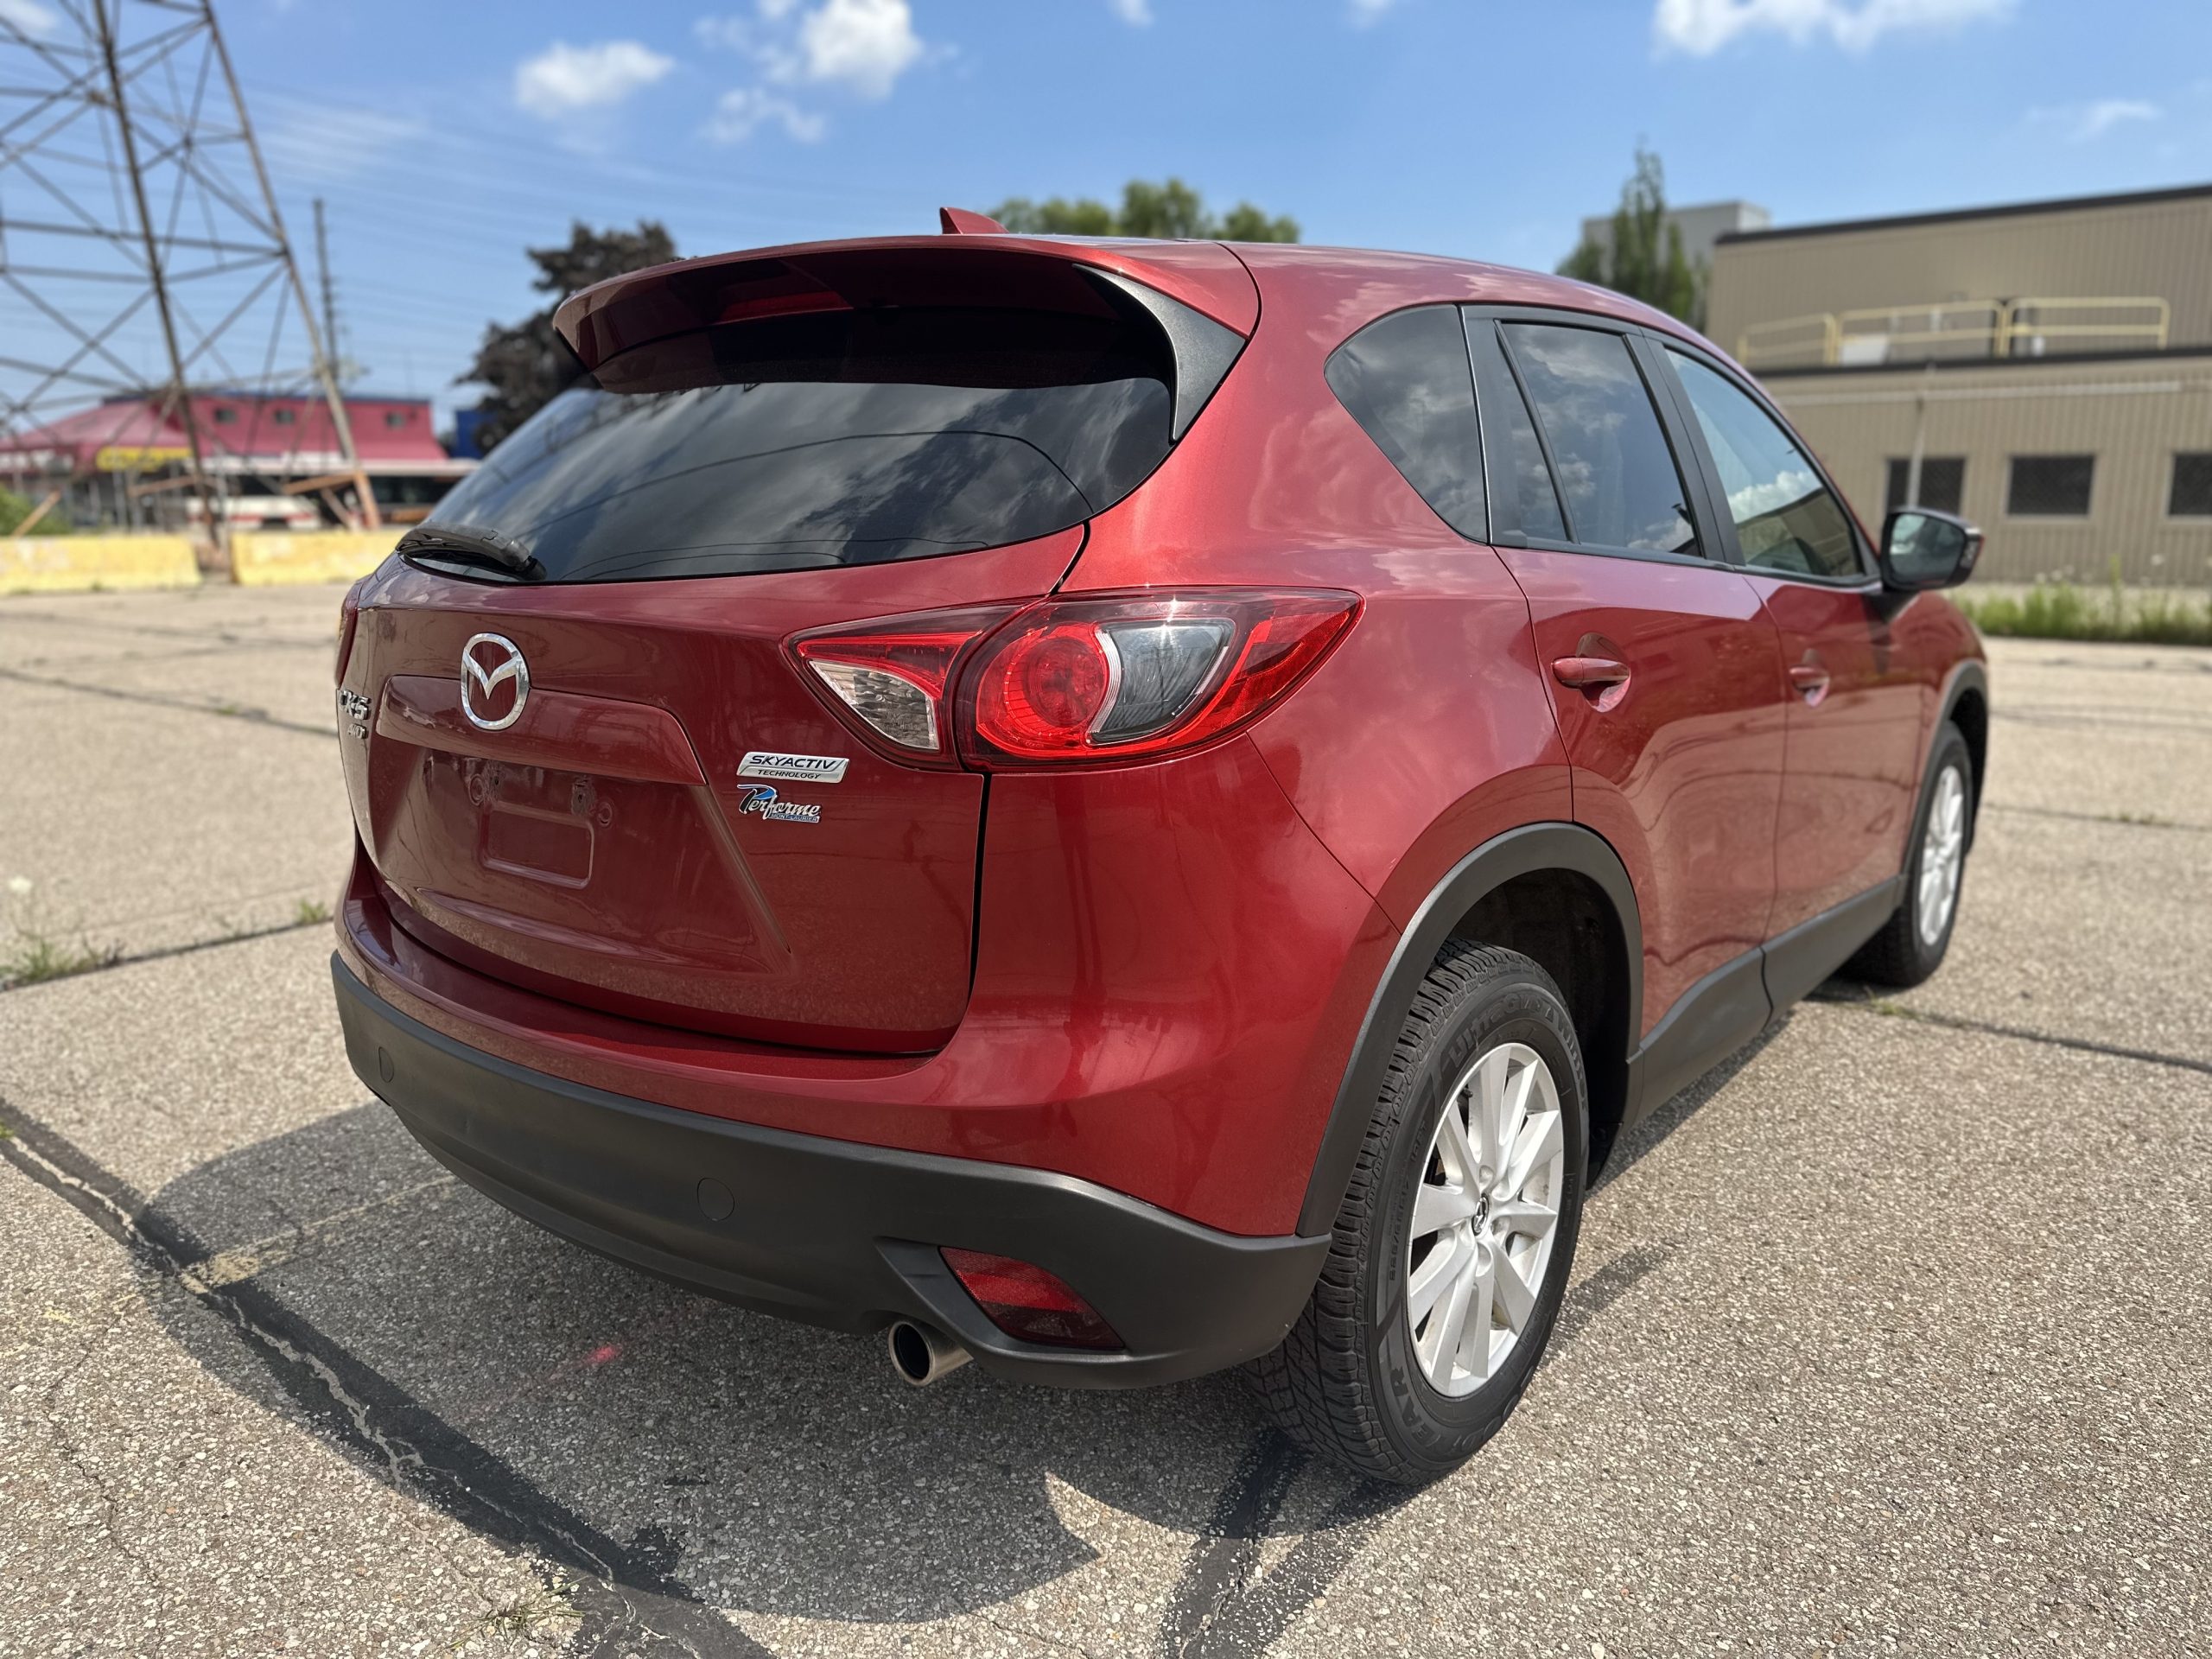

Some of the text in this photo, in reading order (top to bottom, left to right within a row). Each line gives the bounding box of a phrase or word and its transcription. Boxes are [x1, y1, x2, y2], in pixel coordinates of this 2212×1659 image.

[749, 755, 837, 770] SKYACTIV
[757, 769, 821, 779] TECHNOLOGY
[737, 784, 821, 820] Performe
